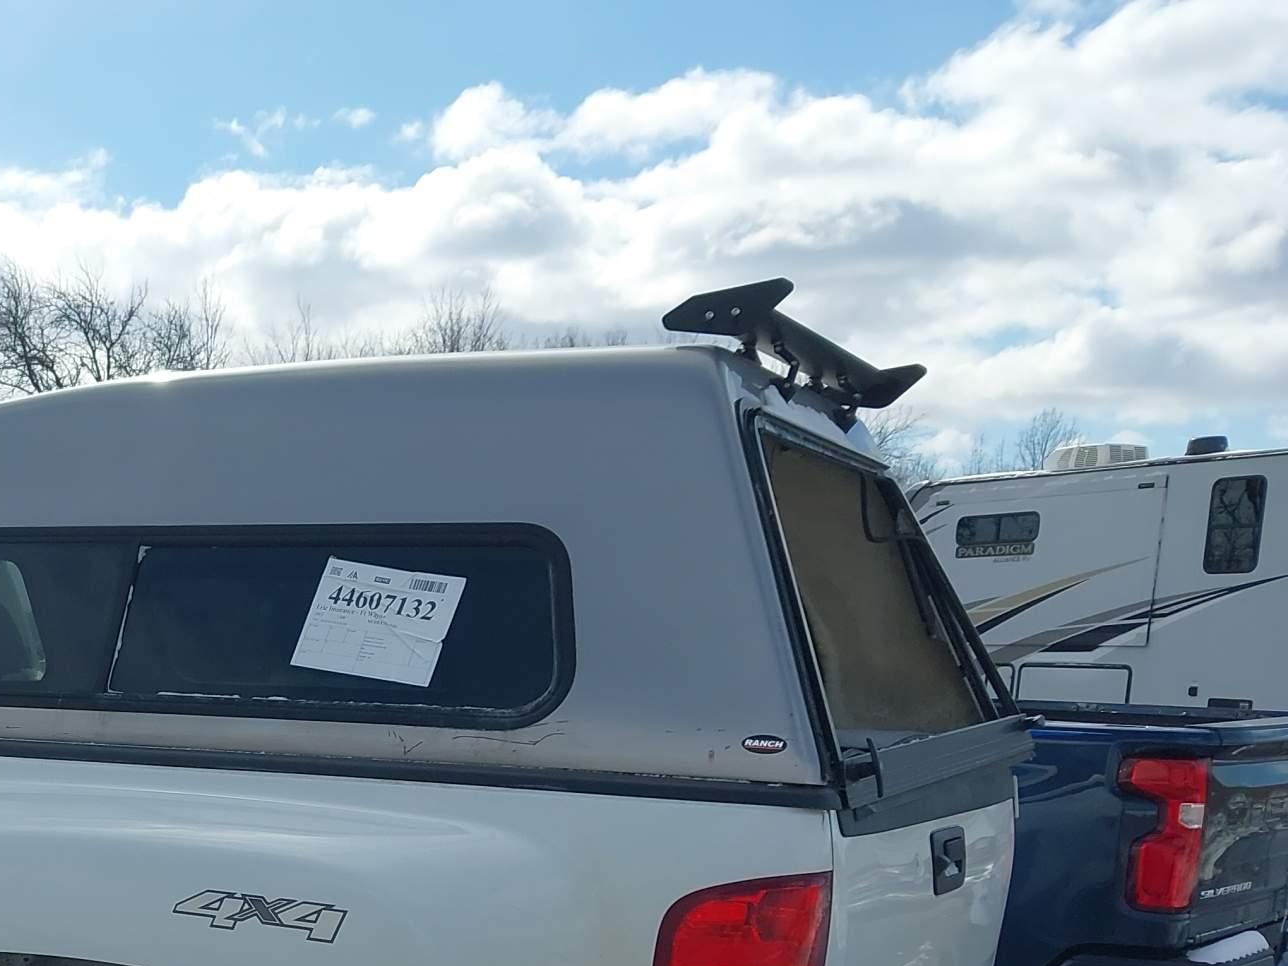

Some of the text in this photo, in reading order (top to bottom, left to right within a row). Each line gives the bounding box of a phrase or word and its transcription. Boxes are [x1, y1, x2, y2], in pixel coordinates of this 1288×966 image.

[957, 544, 1033, 557] PARADIGM
[327, 584, 438, 621] 44607132
[743, 738, 785, 749] RANCH
[1199, 881, 1253, 900] SILVERADO
